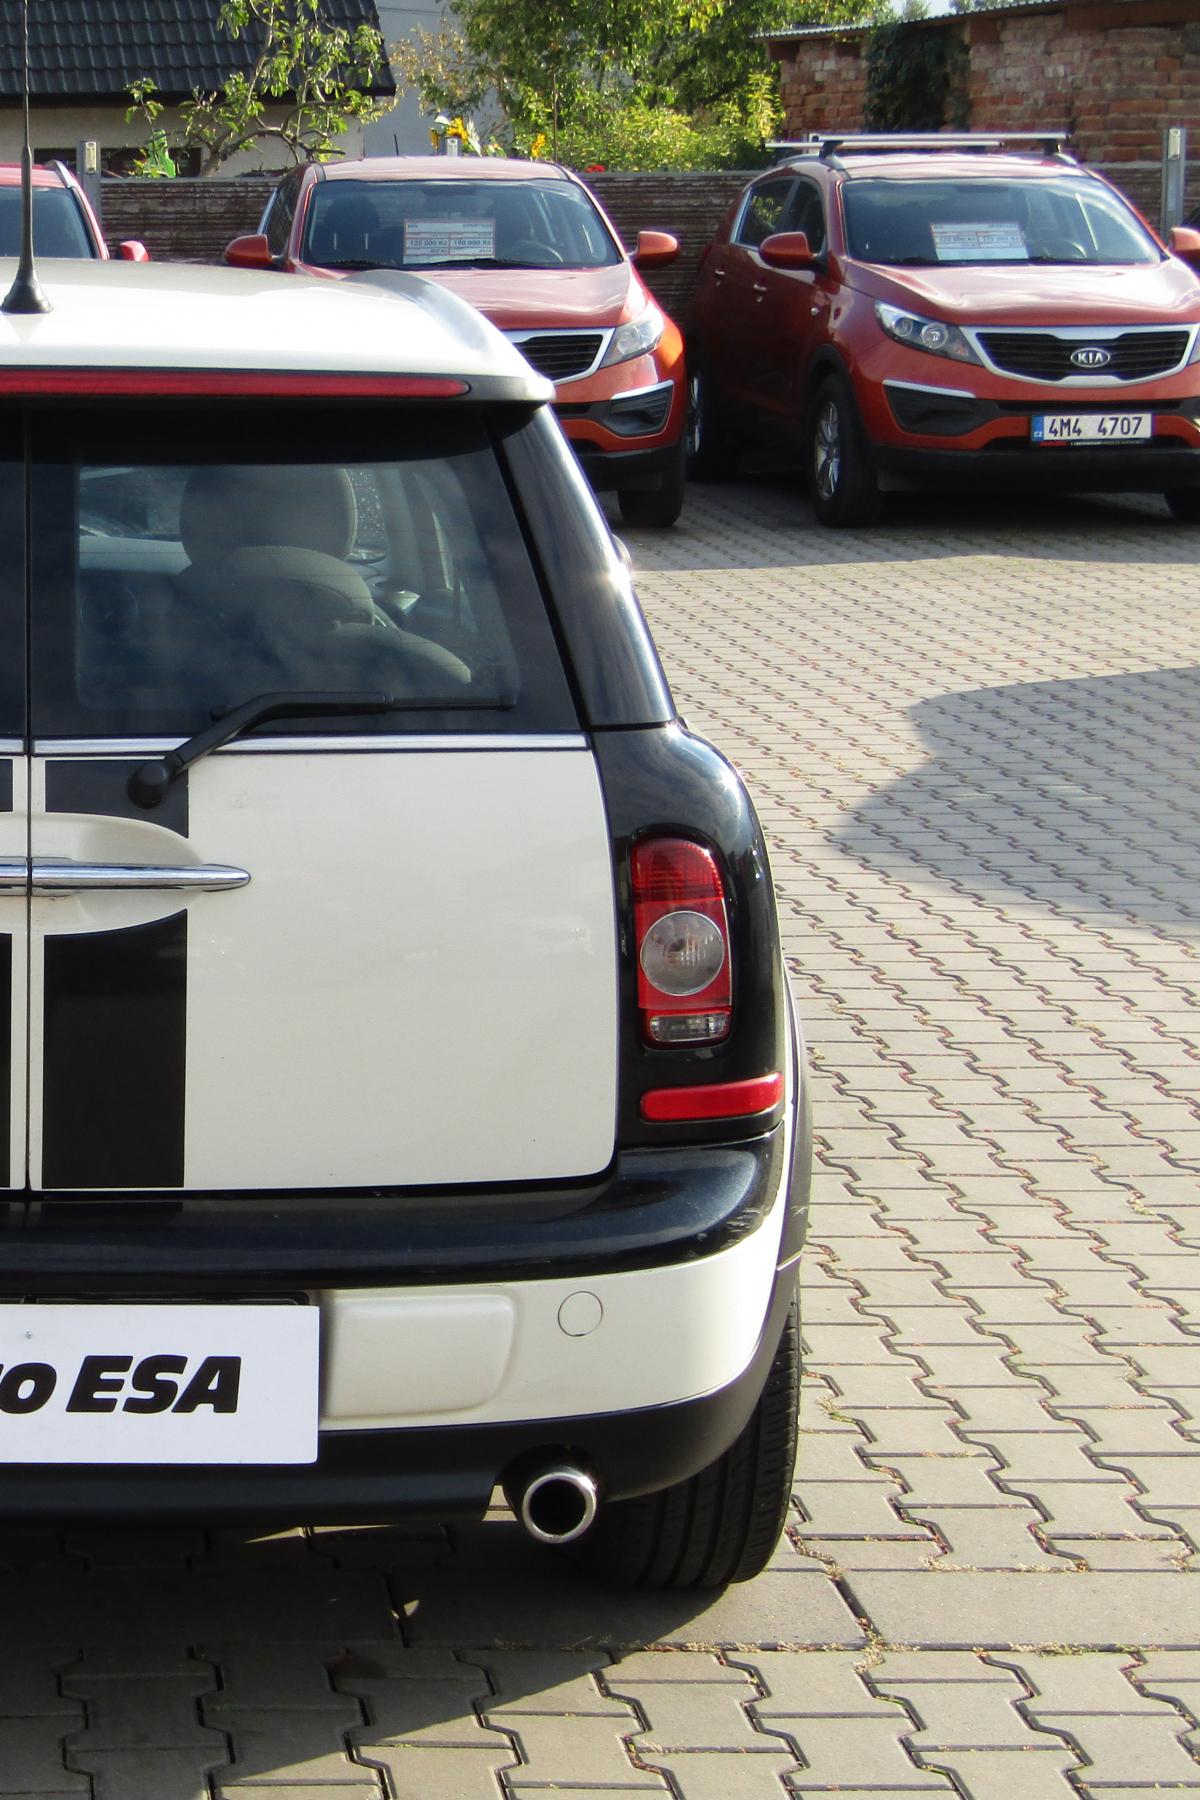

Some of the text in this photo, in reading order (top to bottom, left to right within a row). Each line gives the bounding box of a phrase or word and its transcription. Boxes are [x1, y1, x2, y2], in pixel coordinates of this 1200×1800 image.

[1078, 352, 1103, 364] KIA
[1048, 416, 1143, 437] 4M4 4707
[65, 1354, 242, 1415] ESA
